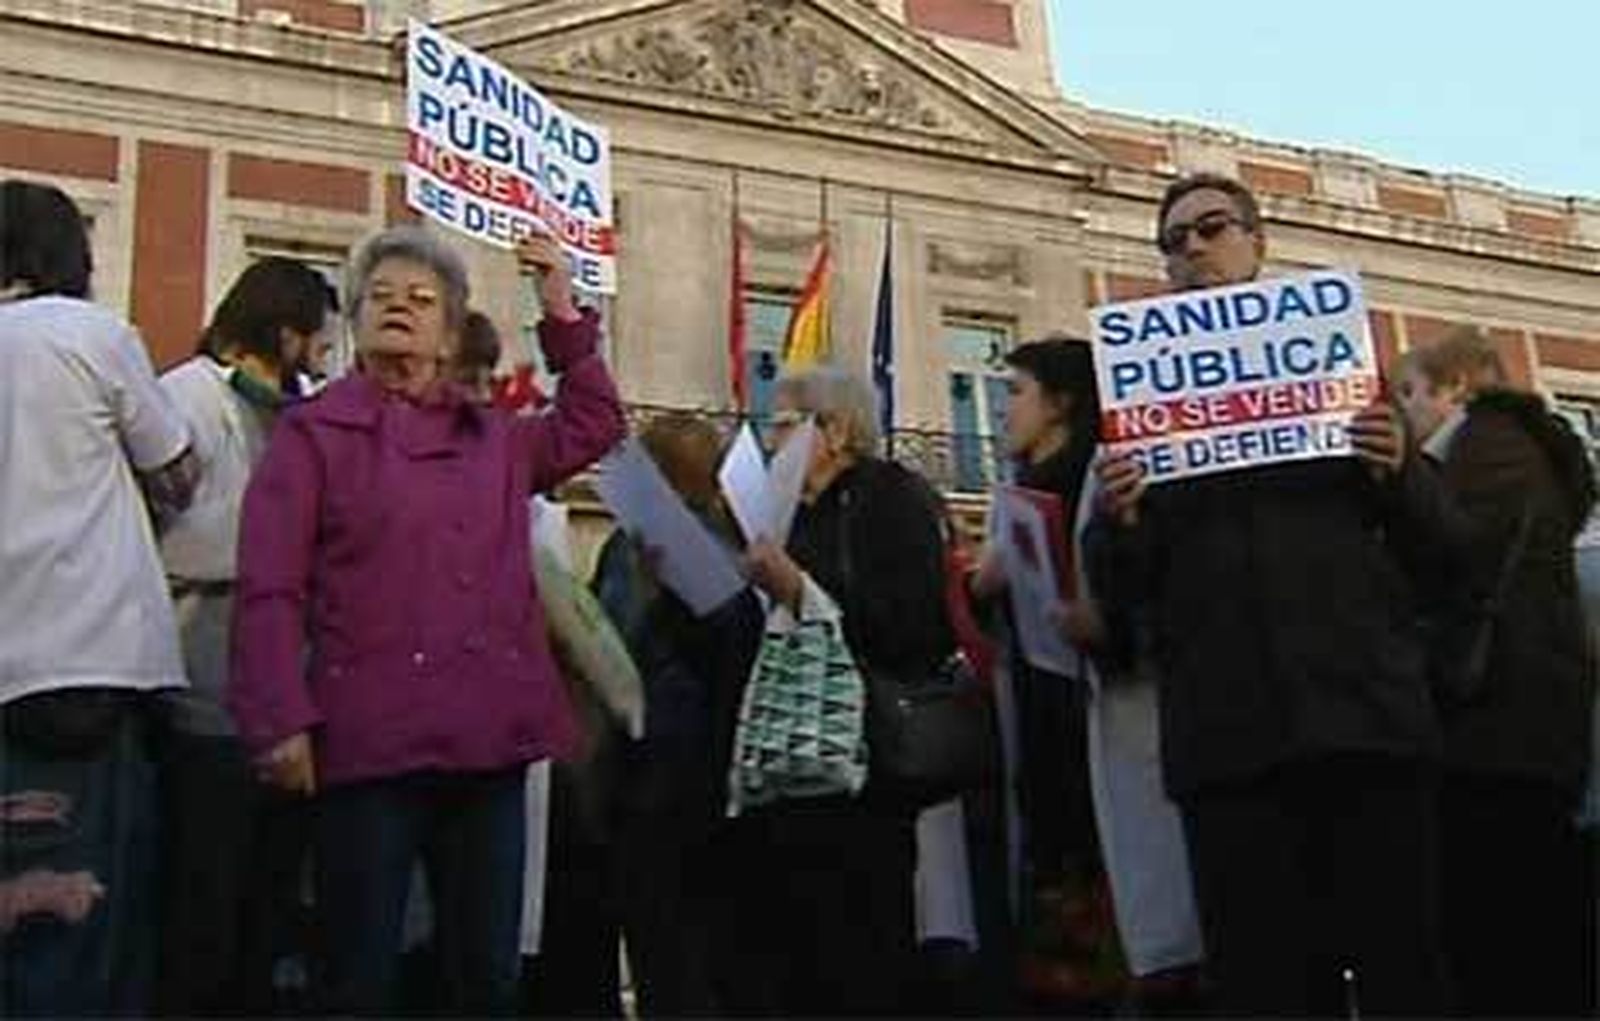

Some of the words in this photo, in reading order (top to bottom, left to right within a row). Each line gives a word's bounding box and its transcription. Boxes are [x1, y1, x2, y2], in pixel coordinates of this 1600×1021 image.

[416, 36, 600, 165] SANIDAD
[412, 133, 456, 178] NO
[466, 163, 510, 199] SE
[418, 92, 600, 217] PÚBLICA
[417, 177, 456, 221] SE
[1100, 278, 1352, 346] SANIDAD
[1112, 332, 1361, 399] PÚBLICA
[1117, 405, 1170, 437] NO
[1180, 398, 1234, 426] SE
[1245, 376, 1370, 416] VENDE
[1186, 420, 1348, 468] DEFIEND
